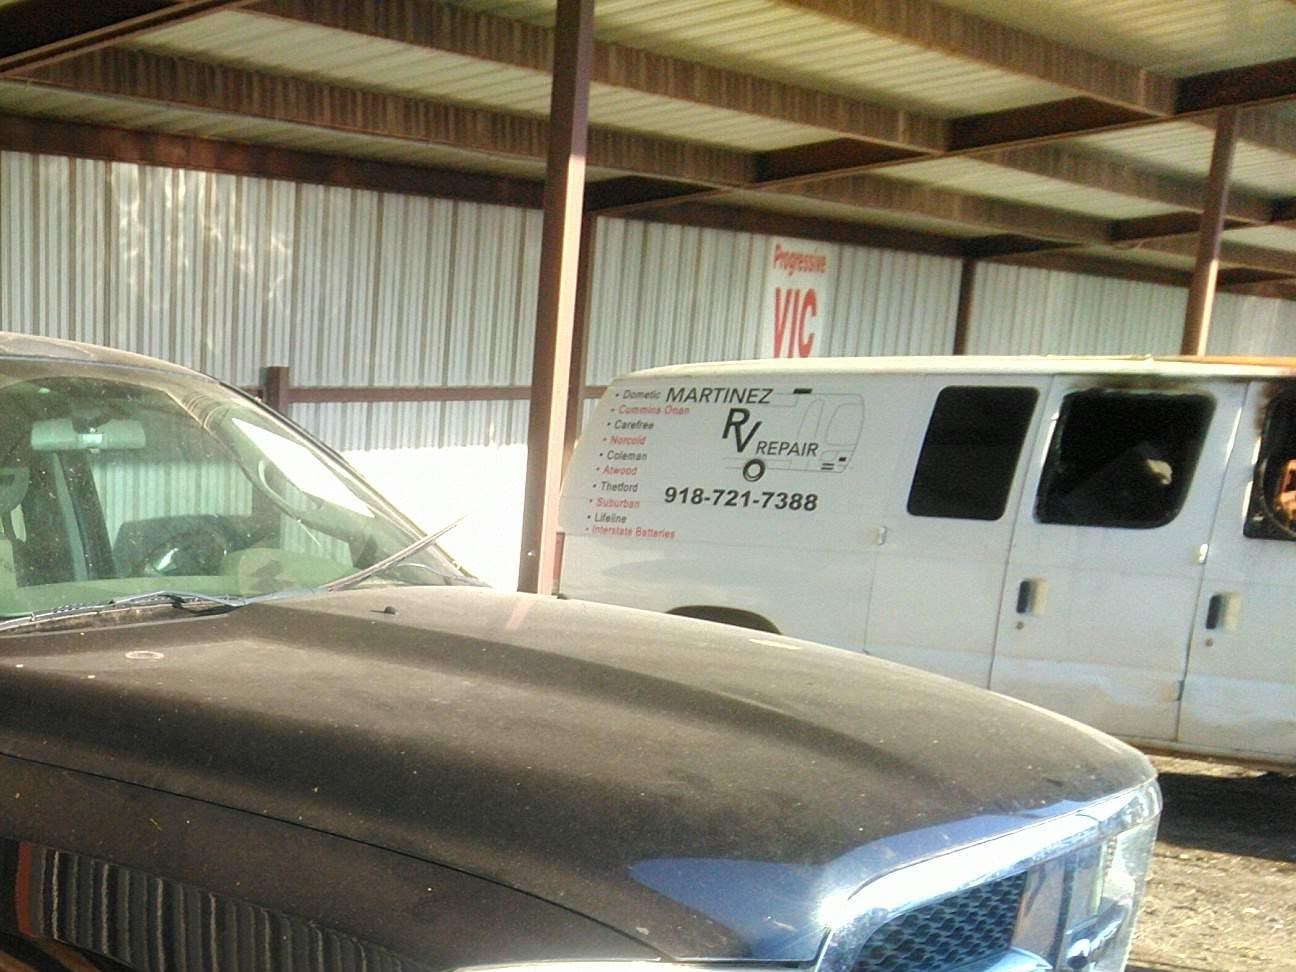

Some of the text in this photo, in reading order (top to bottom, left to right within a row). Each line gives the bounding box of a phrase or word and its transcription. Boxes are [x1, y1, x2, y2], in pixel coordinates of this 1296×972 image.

[622, 389, 661, 400] Dometic
[665, 387, 774, 404] MARTINEZ
[618, 404, 661, 415] Cummins
[614, 419, 654, 430] Carefree
[722, 407, 763, 453] RV
[609, 435, 647, 446] Norcold
[755, 441, 819, 457] REPAIR
[607, 450, 648, 461] Coleman
[603, 465, 638, 476] Atwood
[601, 481, 639, 492] Thetford
[596, 497, 641, 509] Suburban
[664, 486, 819, 511] 918-721-7388
[594, 512, 627, 523] Lifeline
[592, 525, 675, 539] Interstate Batteries
